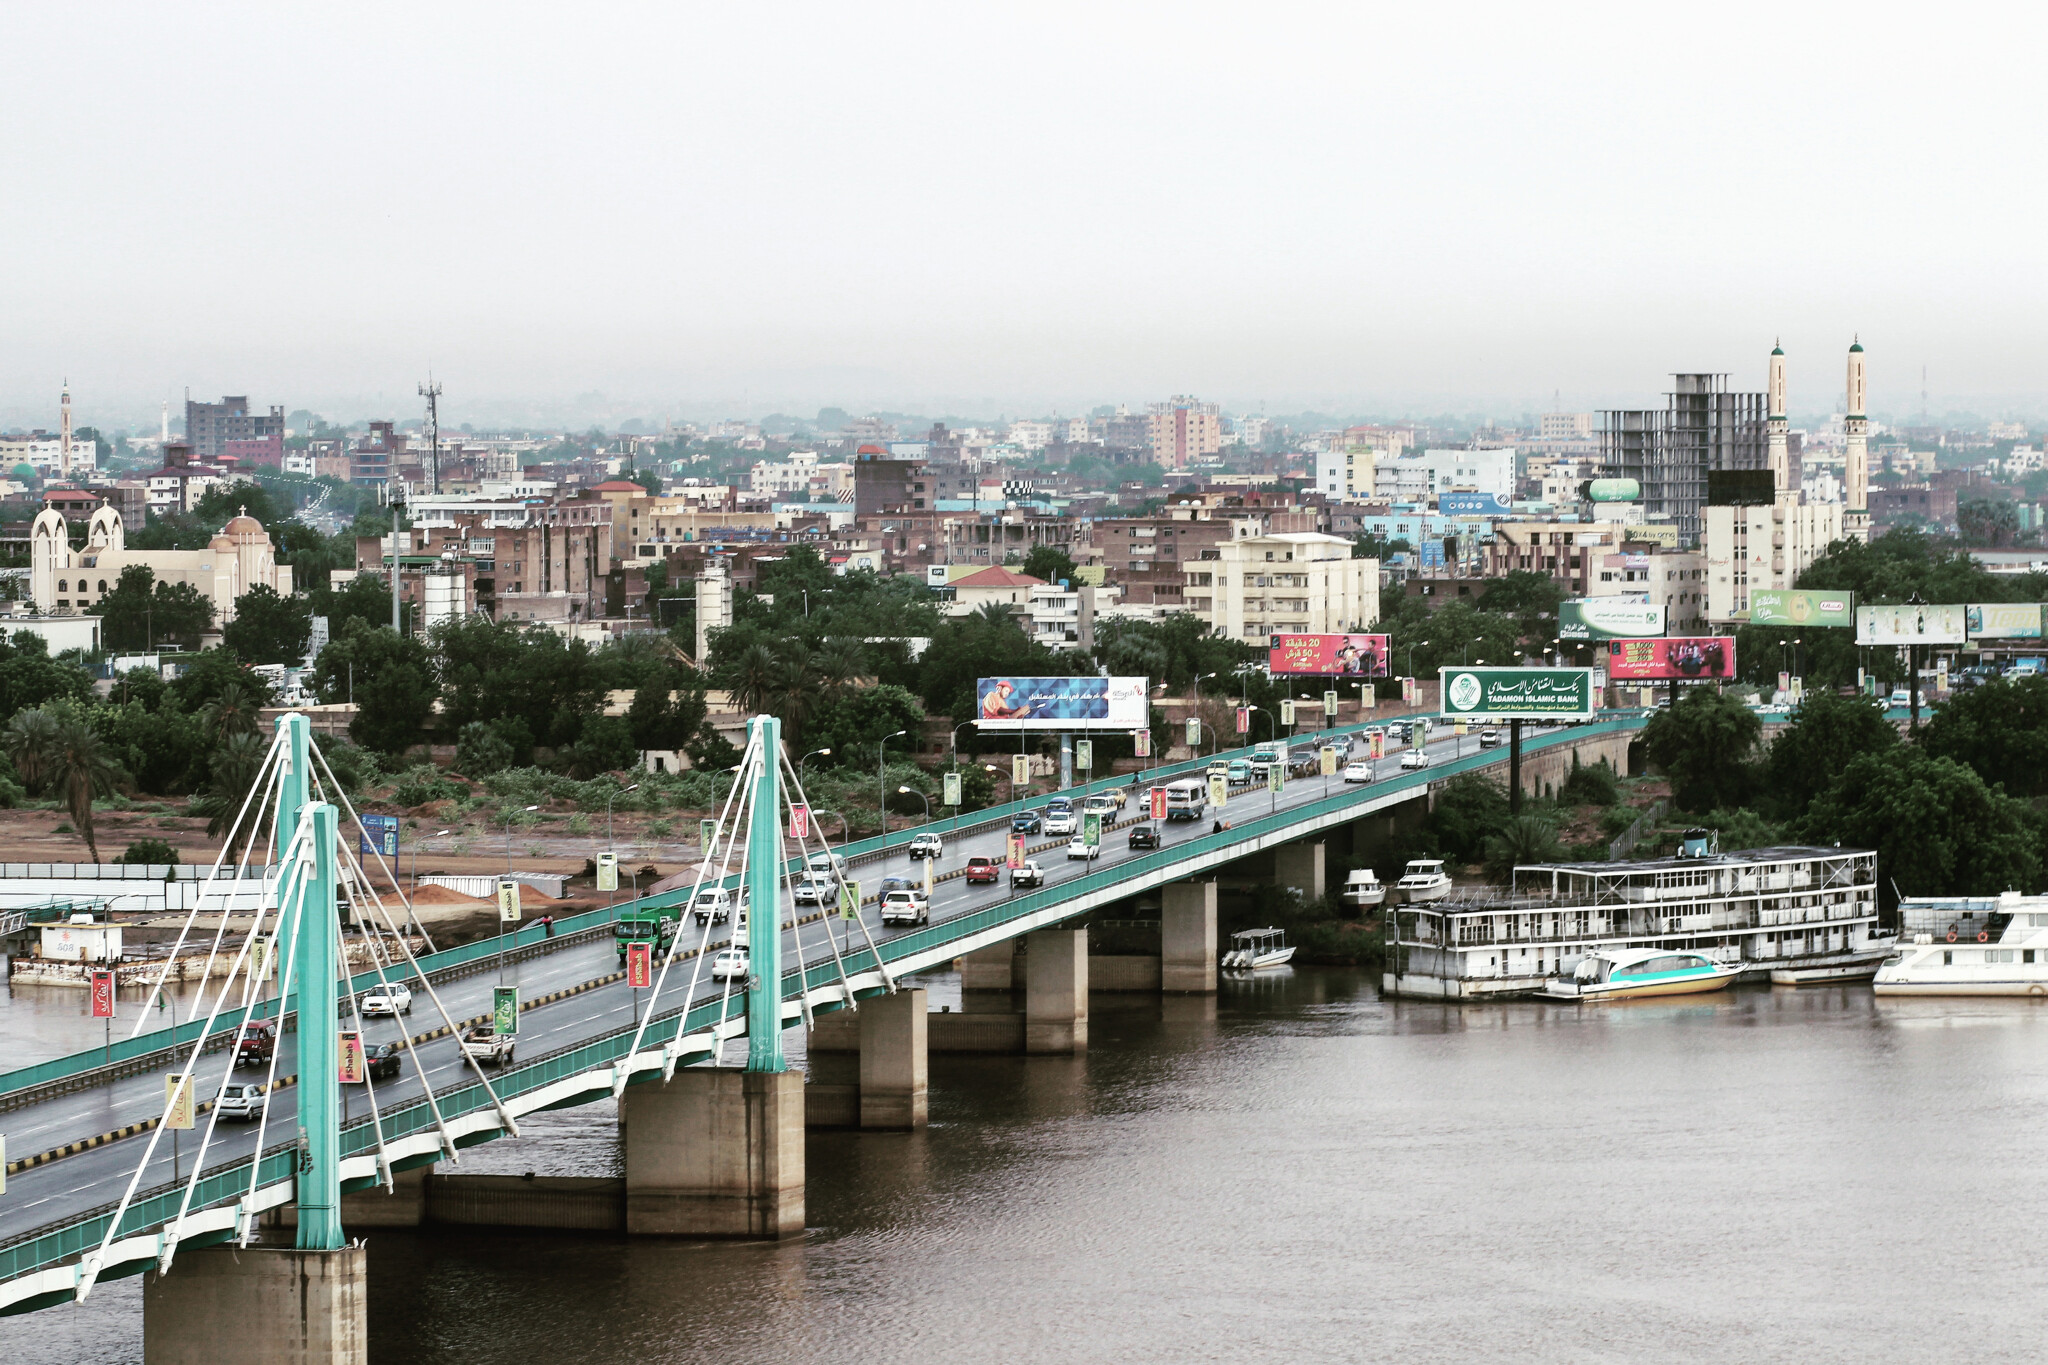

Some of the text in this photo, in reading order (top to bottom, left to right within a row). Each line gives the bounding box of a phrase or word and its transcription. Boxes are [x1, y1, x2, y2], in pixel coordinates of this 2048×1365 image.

[1285, 638, 1307, 649] دقيقة
[1308, 638, 1320, 647] 20
[1302, 649, 1312, 658] 50
[1525, 676, 1554, 695] التضامن
[1552, 672, 1584, 694] بنك
[1028, 693, 1056, 702] المستقبل
[1069, 692, 1080, 702] في
[635, 952, 643, 984] #Shabab
[346, 1043, 354, 1079] #Shabab
